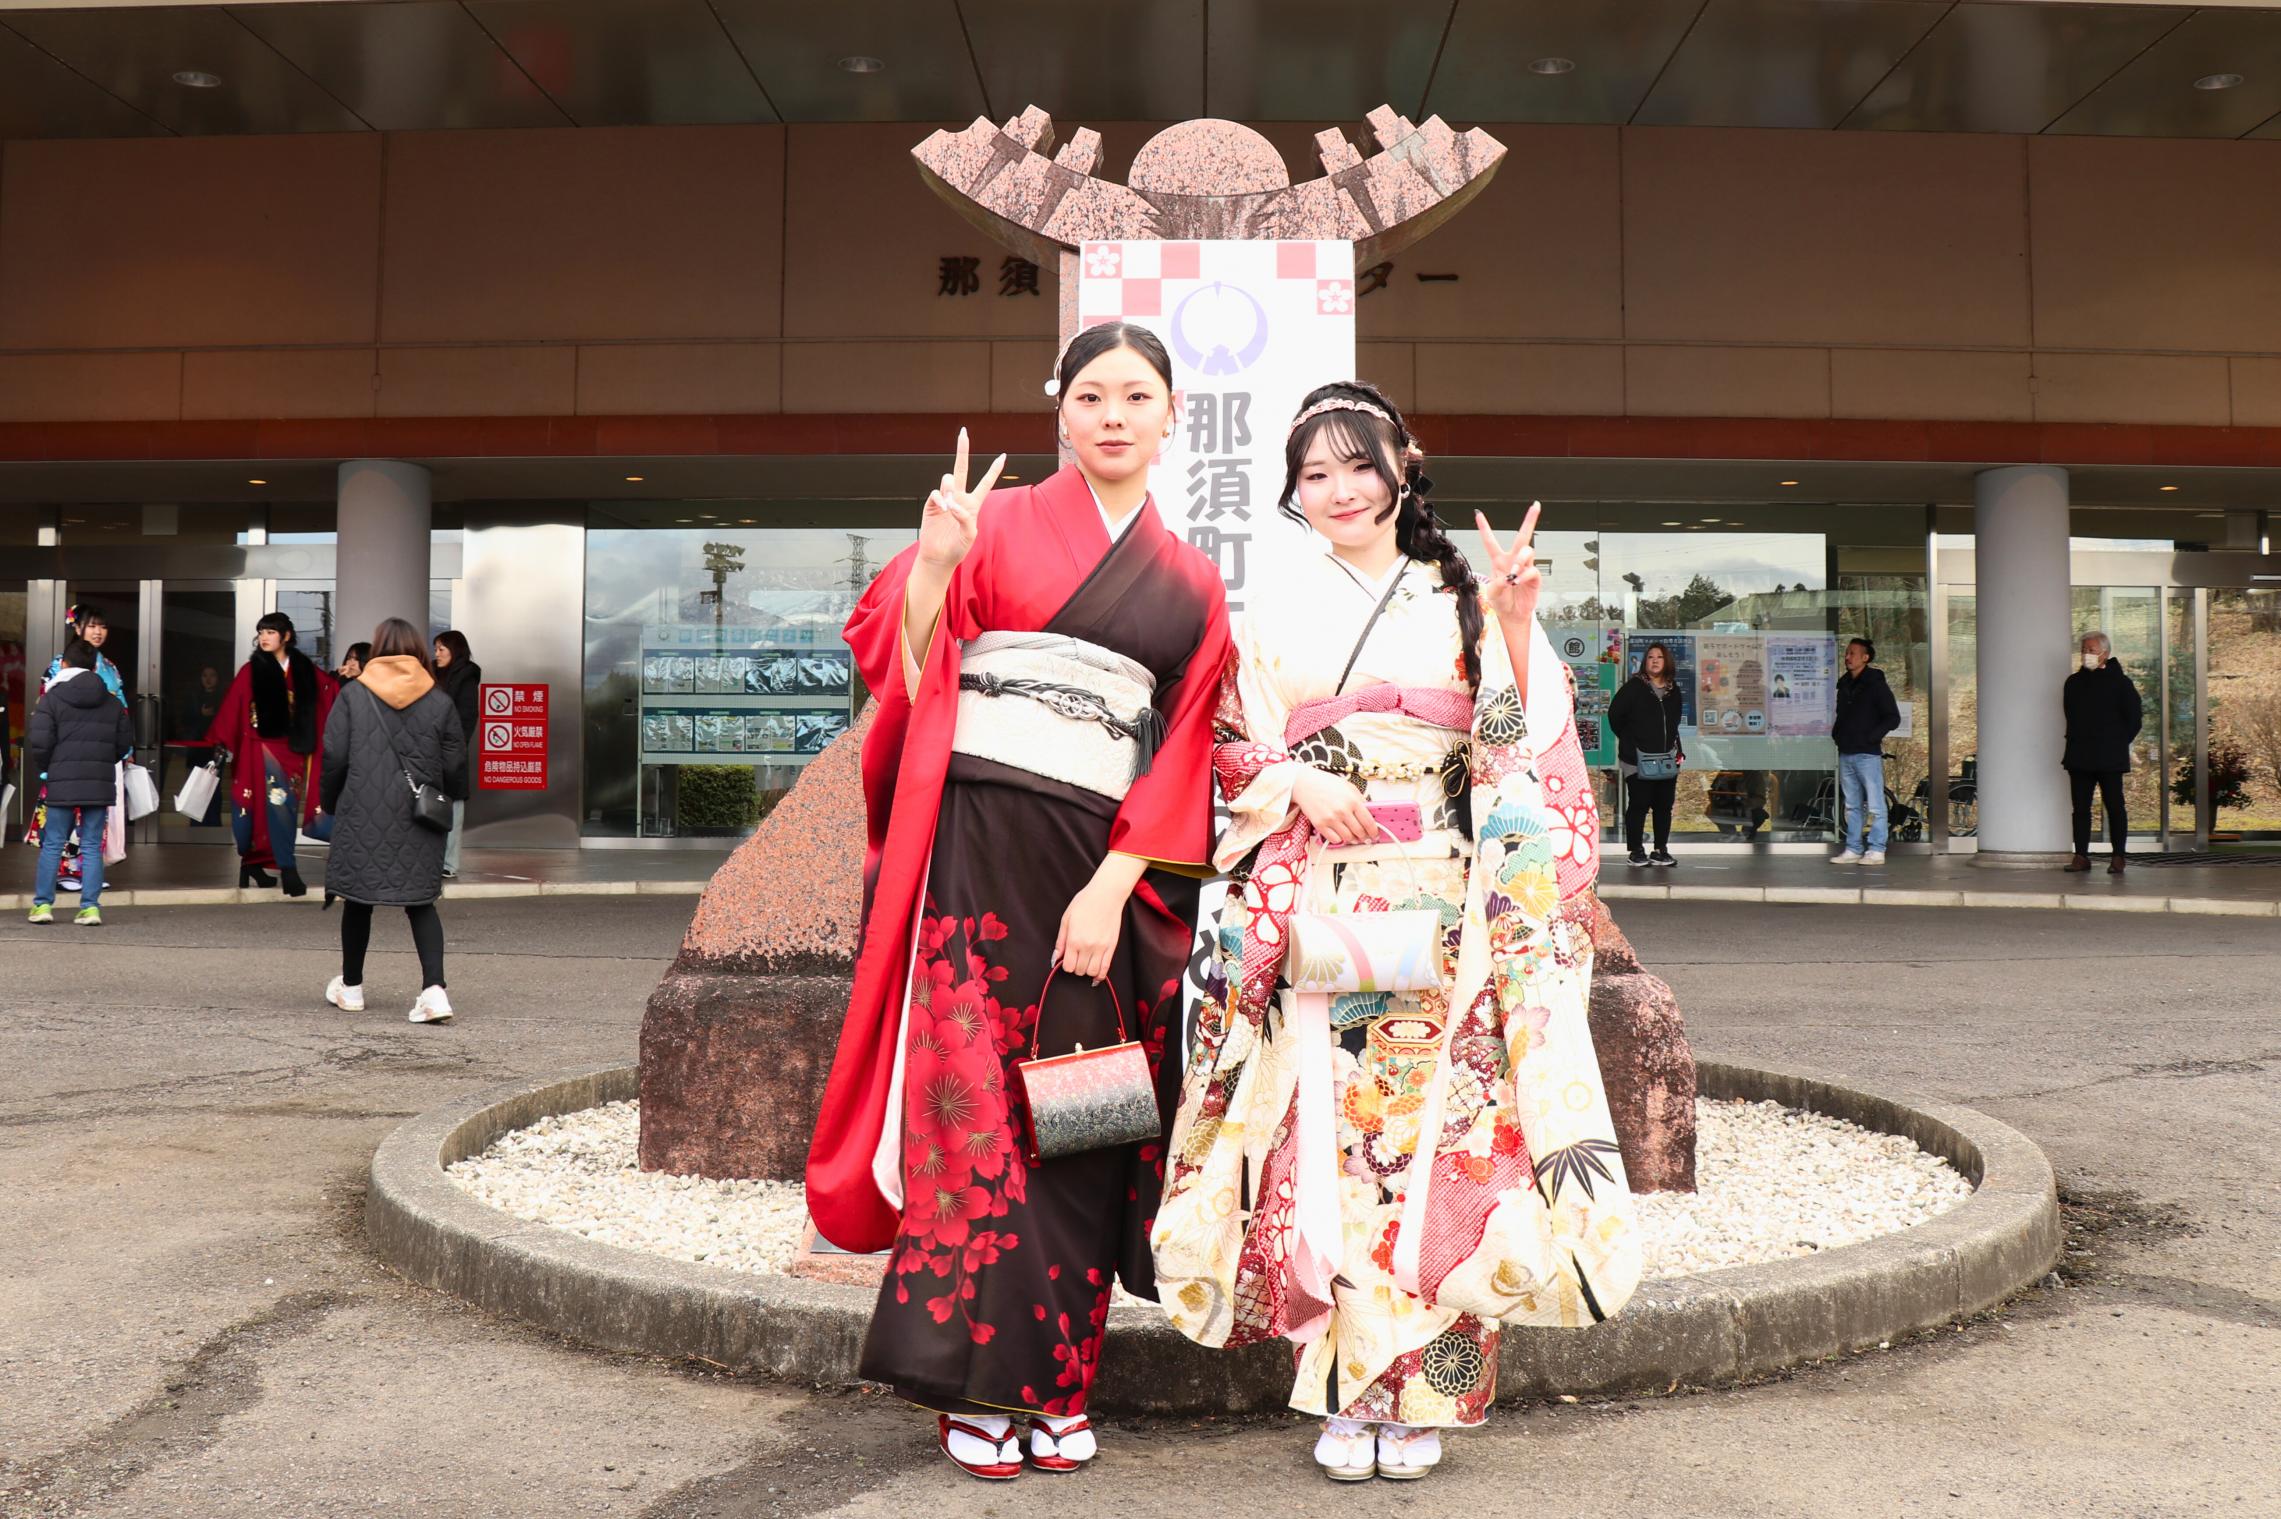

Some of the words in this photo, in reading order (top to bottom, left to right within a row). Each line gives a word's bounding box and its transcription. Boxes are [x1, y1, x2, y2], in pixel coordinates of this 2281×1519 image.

[938, 256, 1040, 296] 那須
[514, 705, 522, 713] NO
[522, 705, 544, 713] SMOKING
[513, 726, 543, 738] 火気厳禁
[484, 760, 542, 773] 危険物品持込厳禁
[492, 776, 523, 784] DANGEROUS
[523, 776, 542, 784] GOODS
